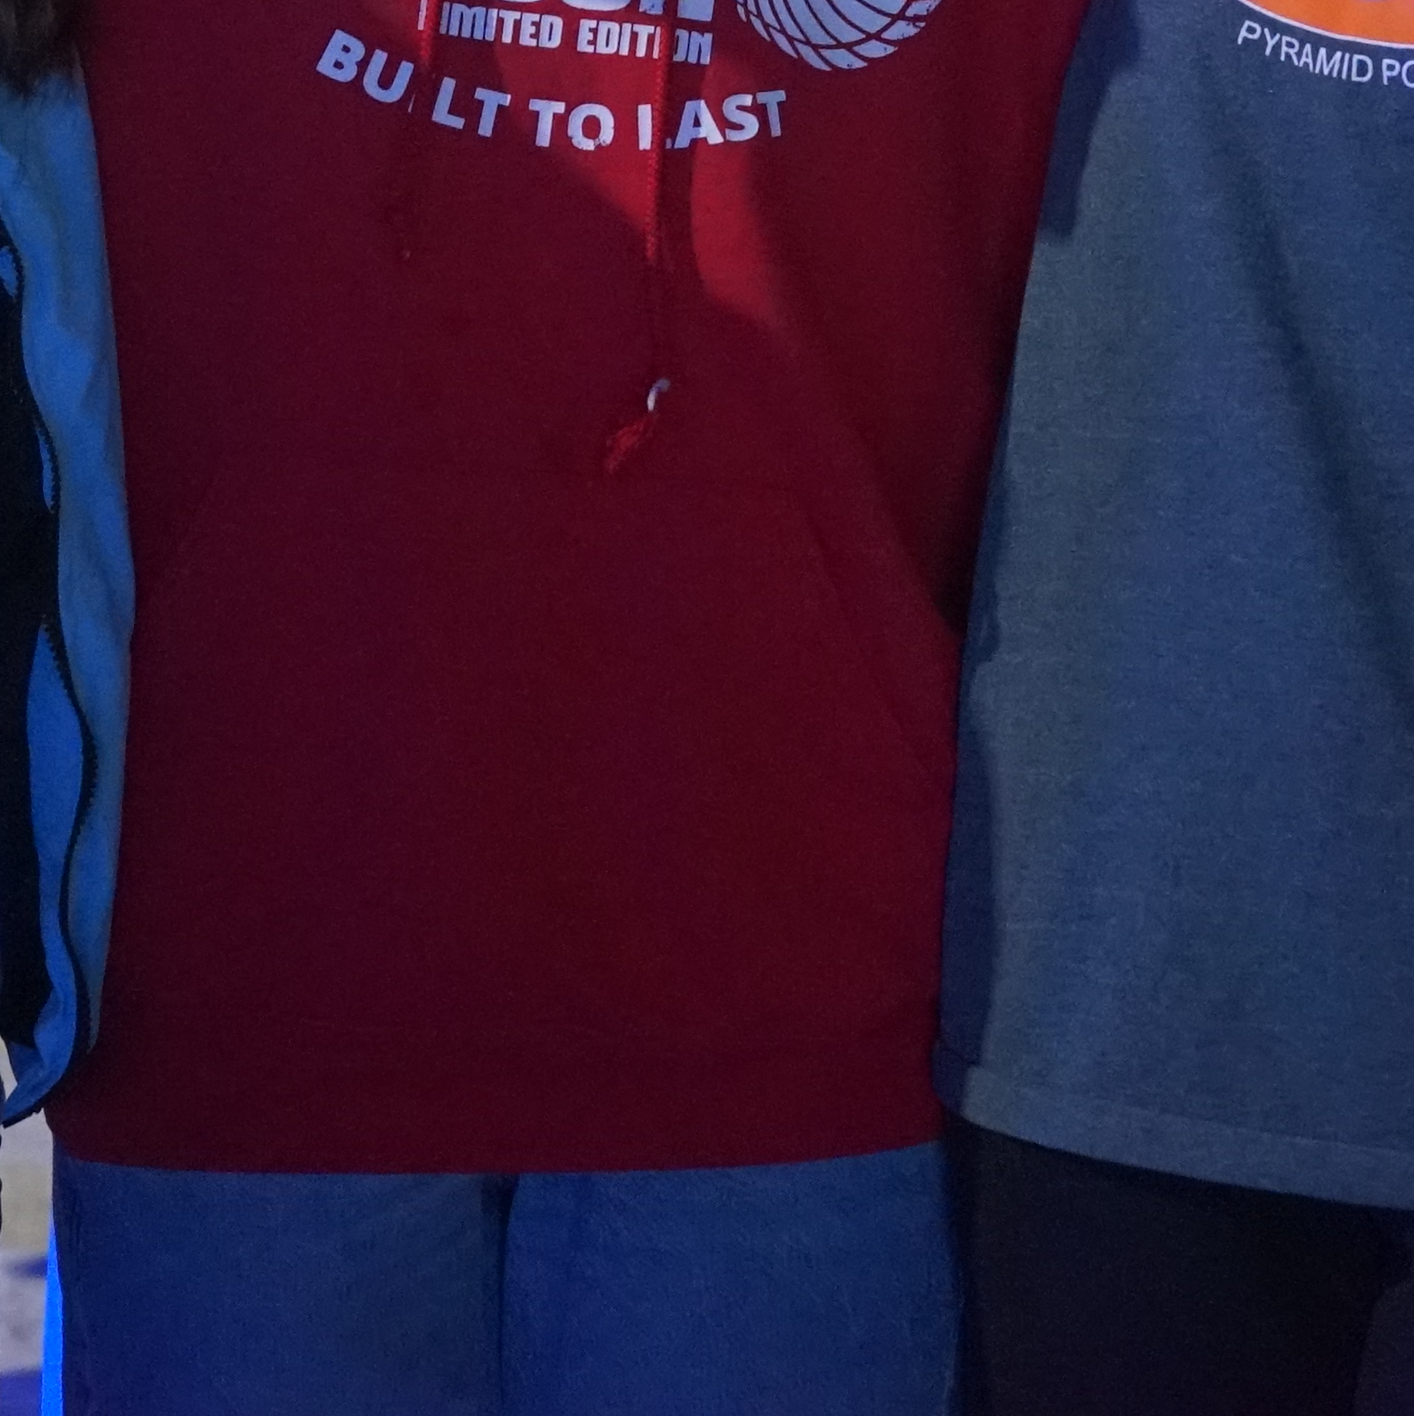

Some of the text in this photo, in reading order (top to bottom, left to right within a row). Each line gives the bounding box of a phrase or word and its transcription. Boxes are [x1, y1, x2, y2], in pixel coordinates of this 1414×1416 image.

[315, 28, 512, 138] BULT
[528, 98, 615, 152] TO
[1237, 19, 1373, 83] PYRAMID
